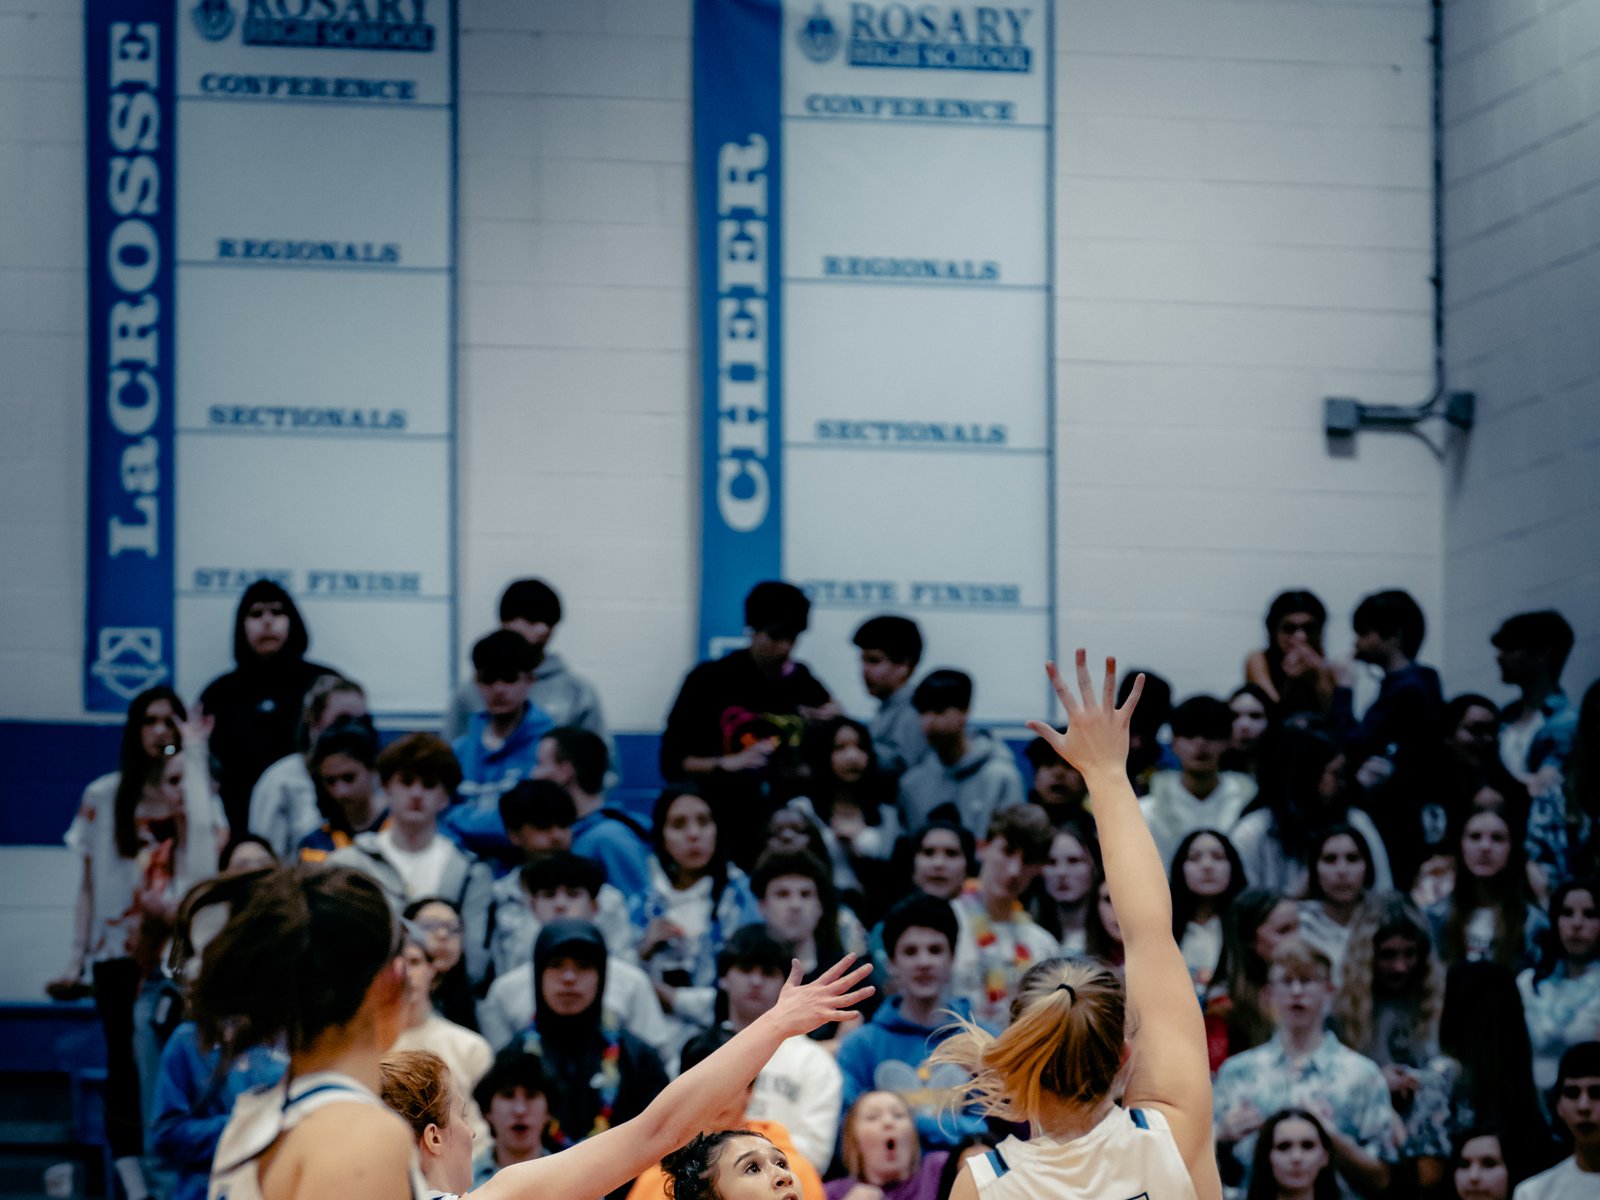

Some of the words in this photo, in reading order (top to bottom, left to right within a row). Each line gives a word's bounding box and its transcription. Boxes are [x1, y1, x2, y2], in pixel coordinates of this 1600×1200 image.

[851, 3, 1031, 46] ROSARY
[200, 73, 417, 100] CONFERENCE
[806, 93, 1017, 121] CONFERENCE
[216, 238, 400, 263] REGIONALS
[823, 255, 1000, 281] REGIONALS
[108, 22, 160, 557] LaCROSSE
[717, 133, 769, 532] CHEER
[208, 404, 407, 430] SECTIONALS
[815, 419, 1007, 445] SECTIONALS
[306, 570, 421, 593] FINISH
[910, 582, 1020, 605] FINISH
